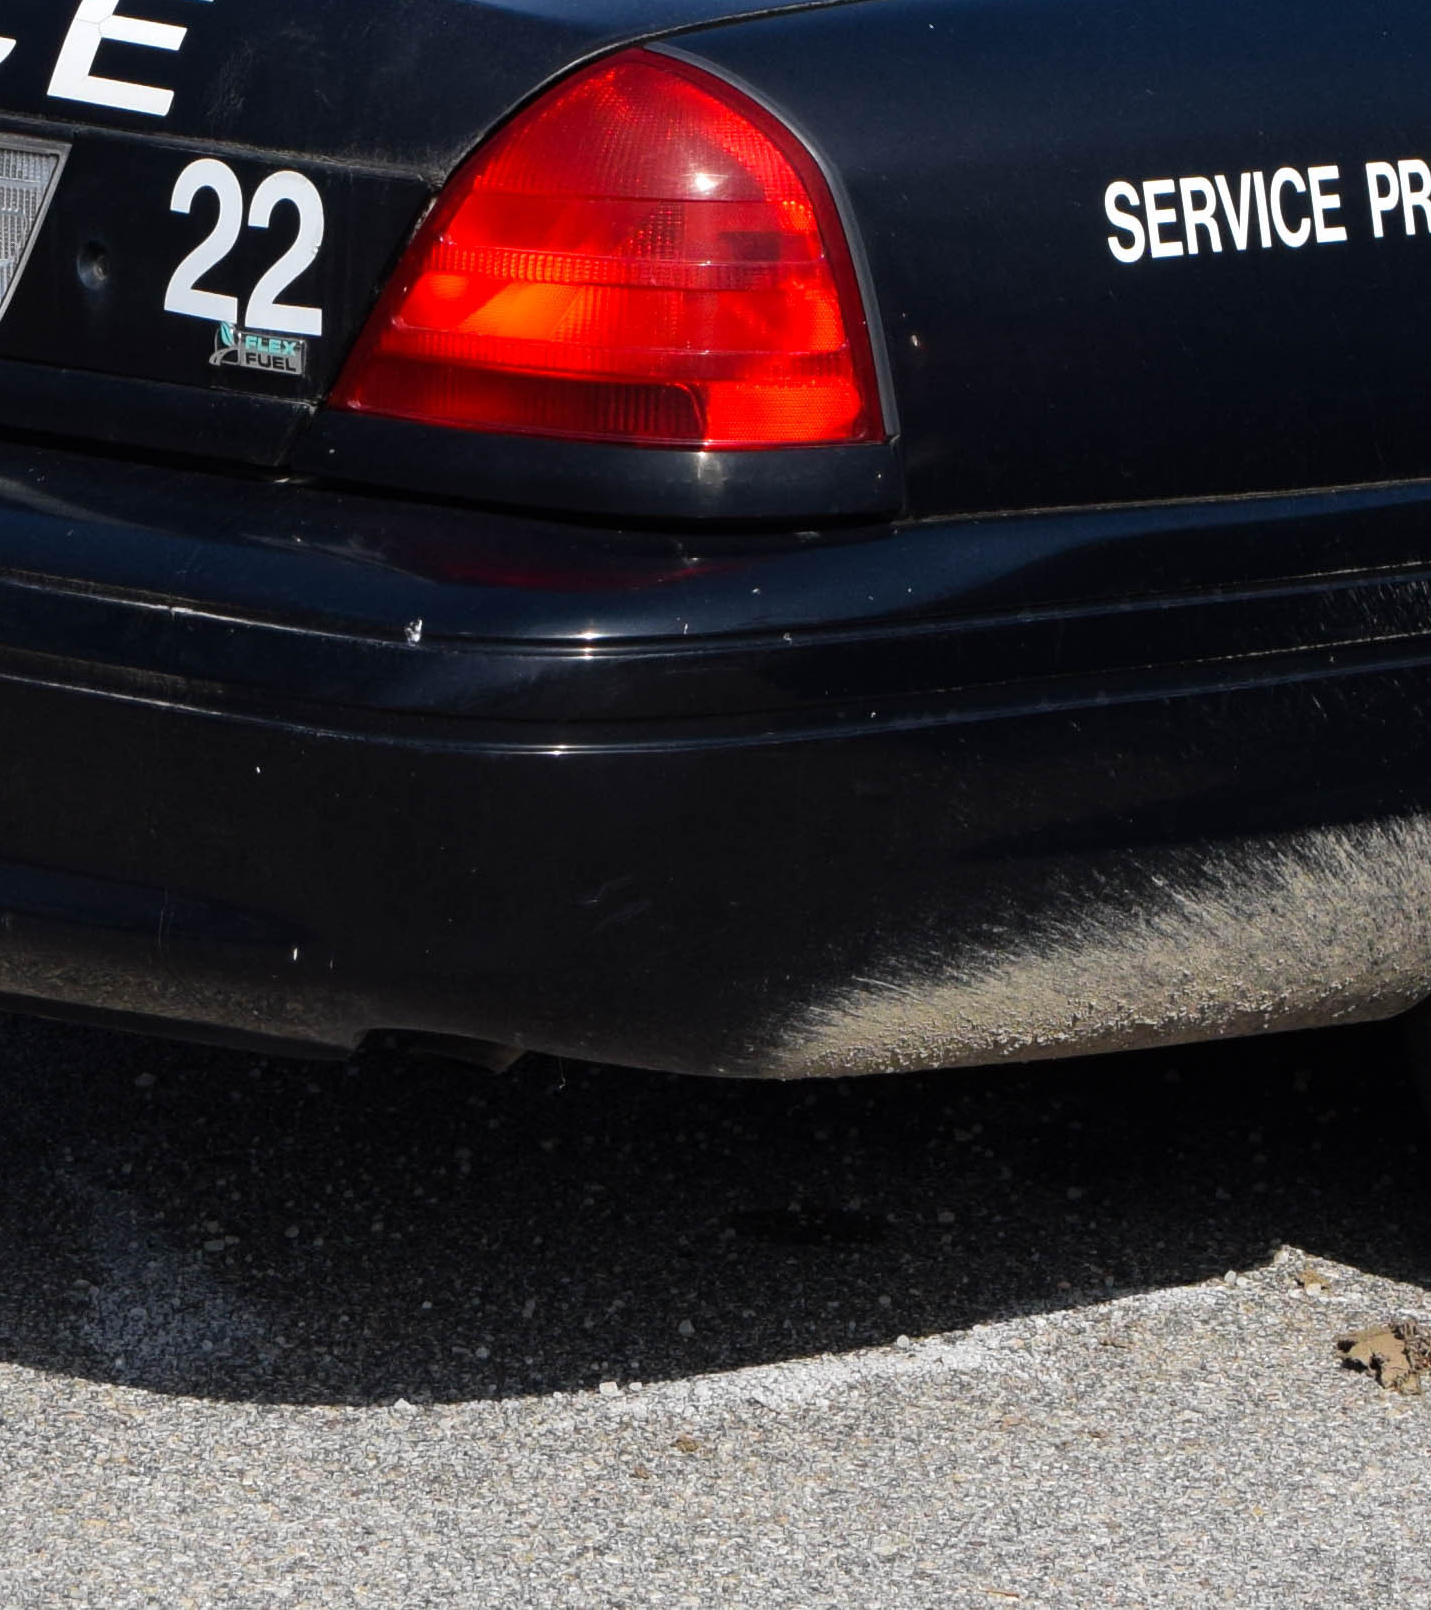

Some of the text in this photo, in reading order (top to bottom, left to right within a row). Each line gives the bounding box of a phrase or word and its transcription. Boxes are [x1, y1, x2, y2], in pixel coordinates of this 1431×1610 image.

[1104, 165, 1347, 263] SERVICE
[163, 158, 325, 336] 22
[244, 335, 299, 356] FLEX
[244, 351, 298, 373] FUEL
